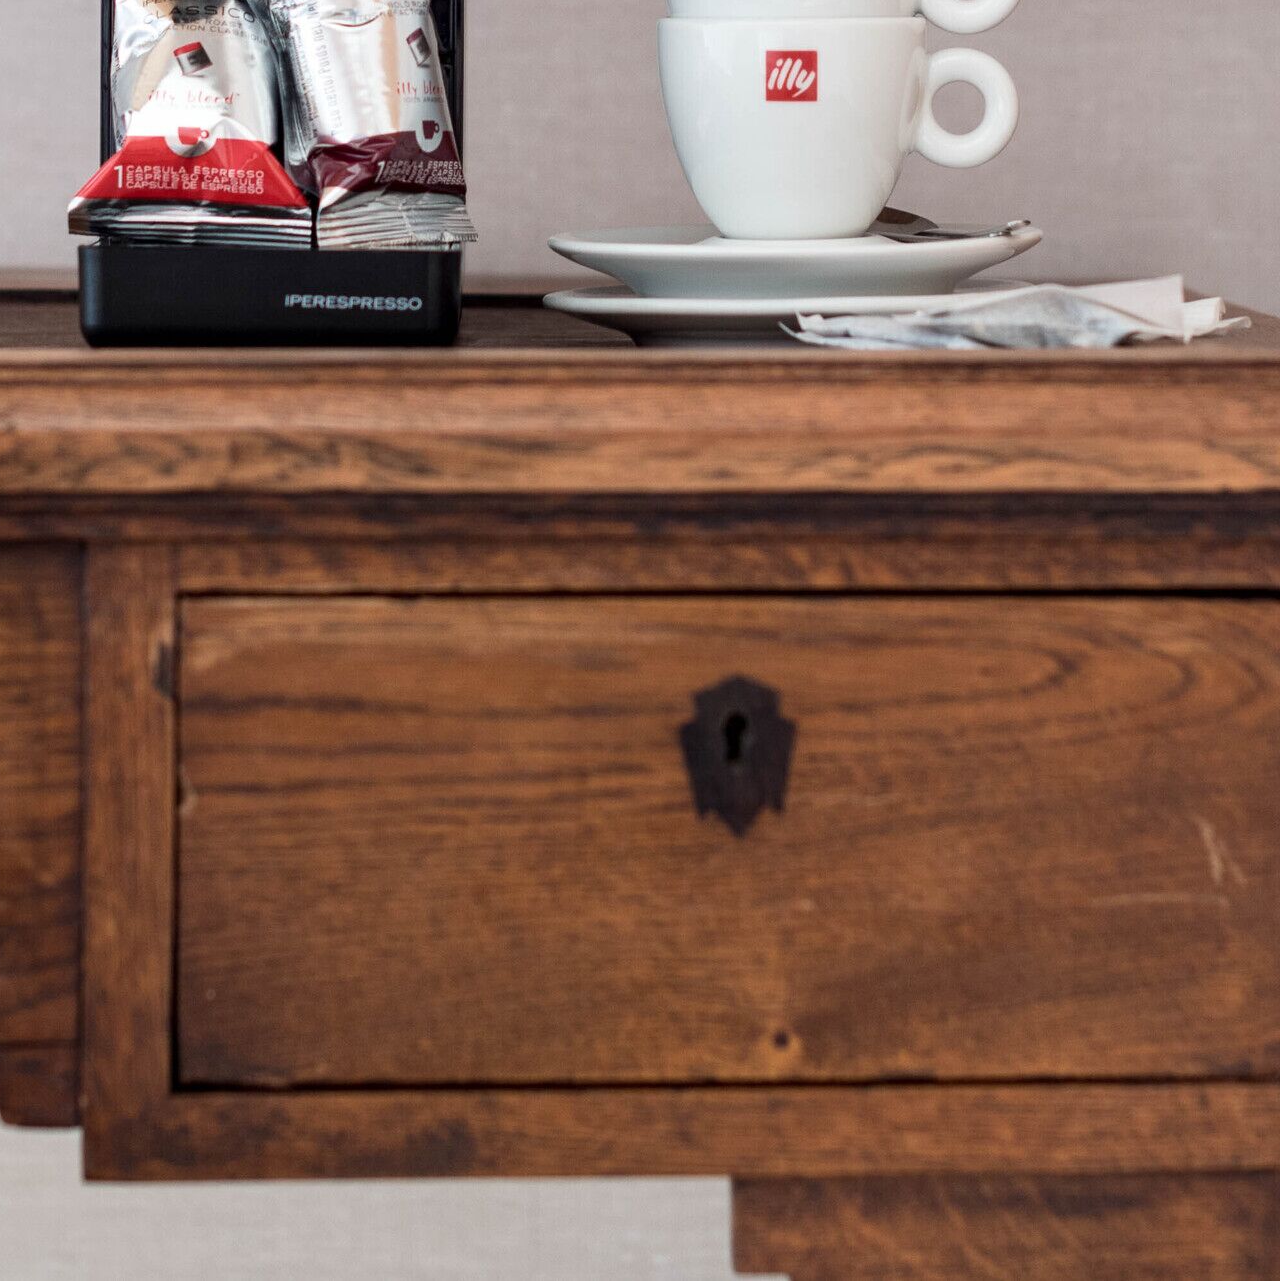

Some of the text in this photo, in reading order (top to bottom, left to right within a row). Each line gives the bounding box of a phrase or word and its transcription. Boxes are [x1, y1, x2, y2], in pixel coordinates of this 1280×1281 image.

[143, 5, 255, 24] CLASSICO
[767, 57, 816, 98] illy
[126, 165, 265, 178] CAPSULA ESPRESSO
[428, 160, 463, 169] ESPRES
[114, 165, 123, 189] 1
[126, 173, 264, 187] ESPRESSO CAPSULE
[374, 161, 386, 184] 1
[431, 169, 464, 177] CAPSUL
[126, 181, 265, 195] CAPSULE DE ESPRESSO
[284, 294, 423, 311] IPERESPRESSO
